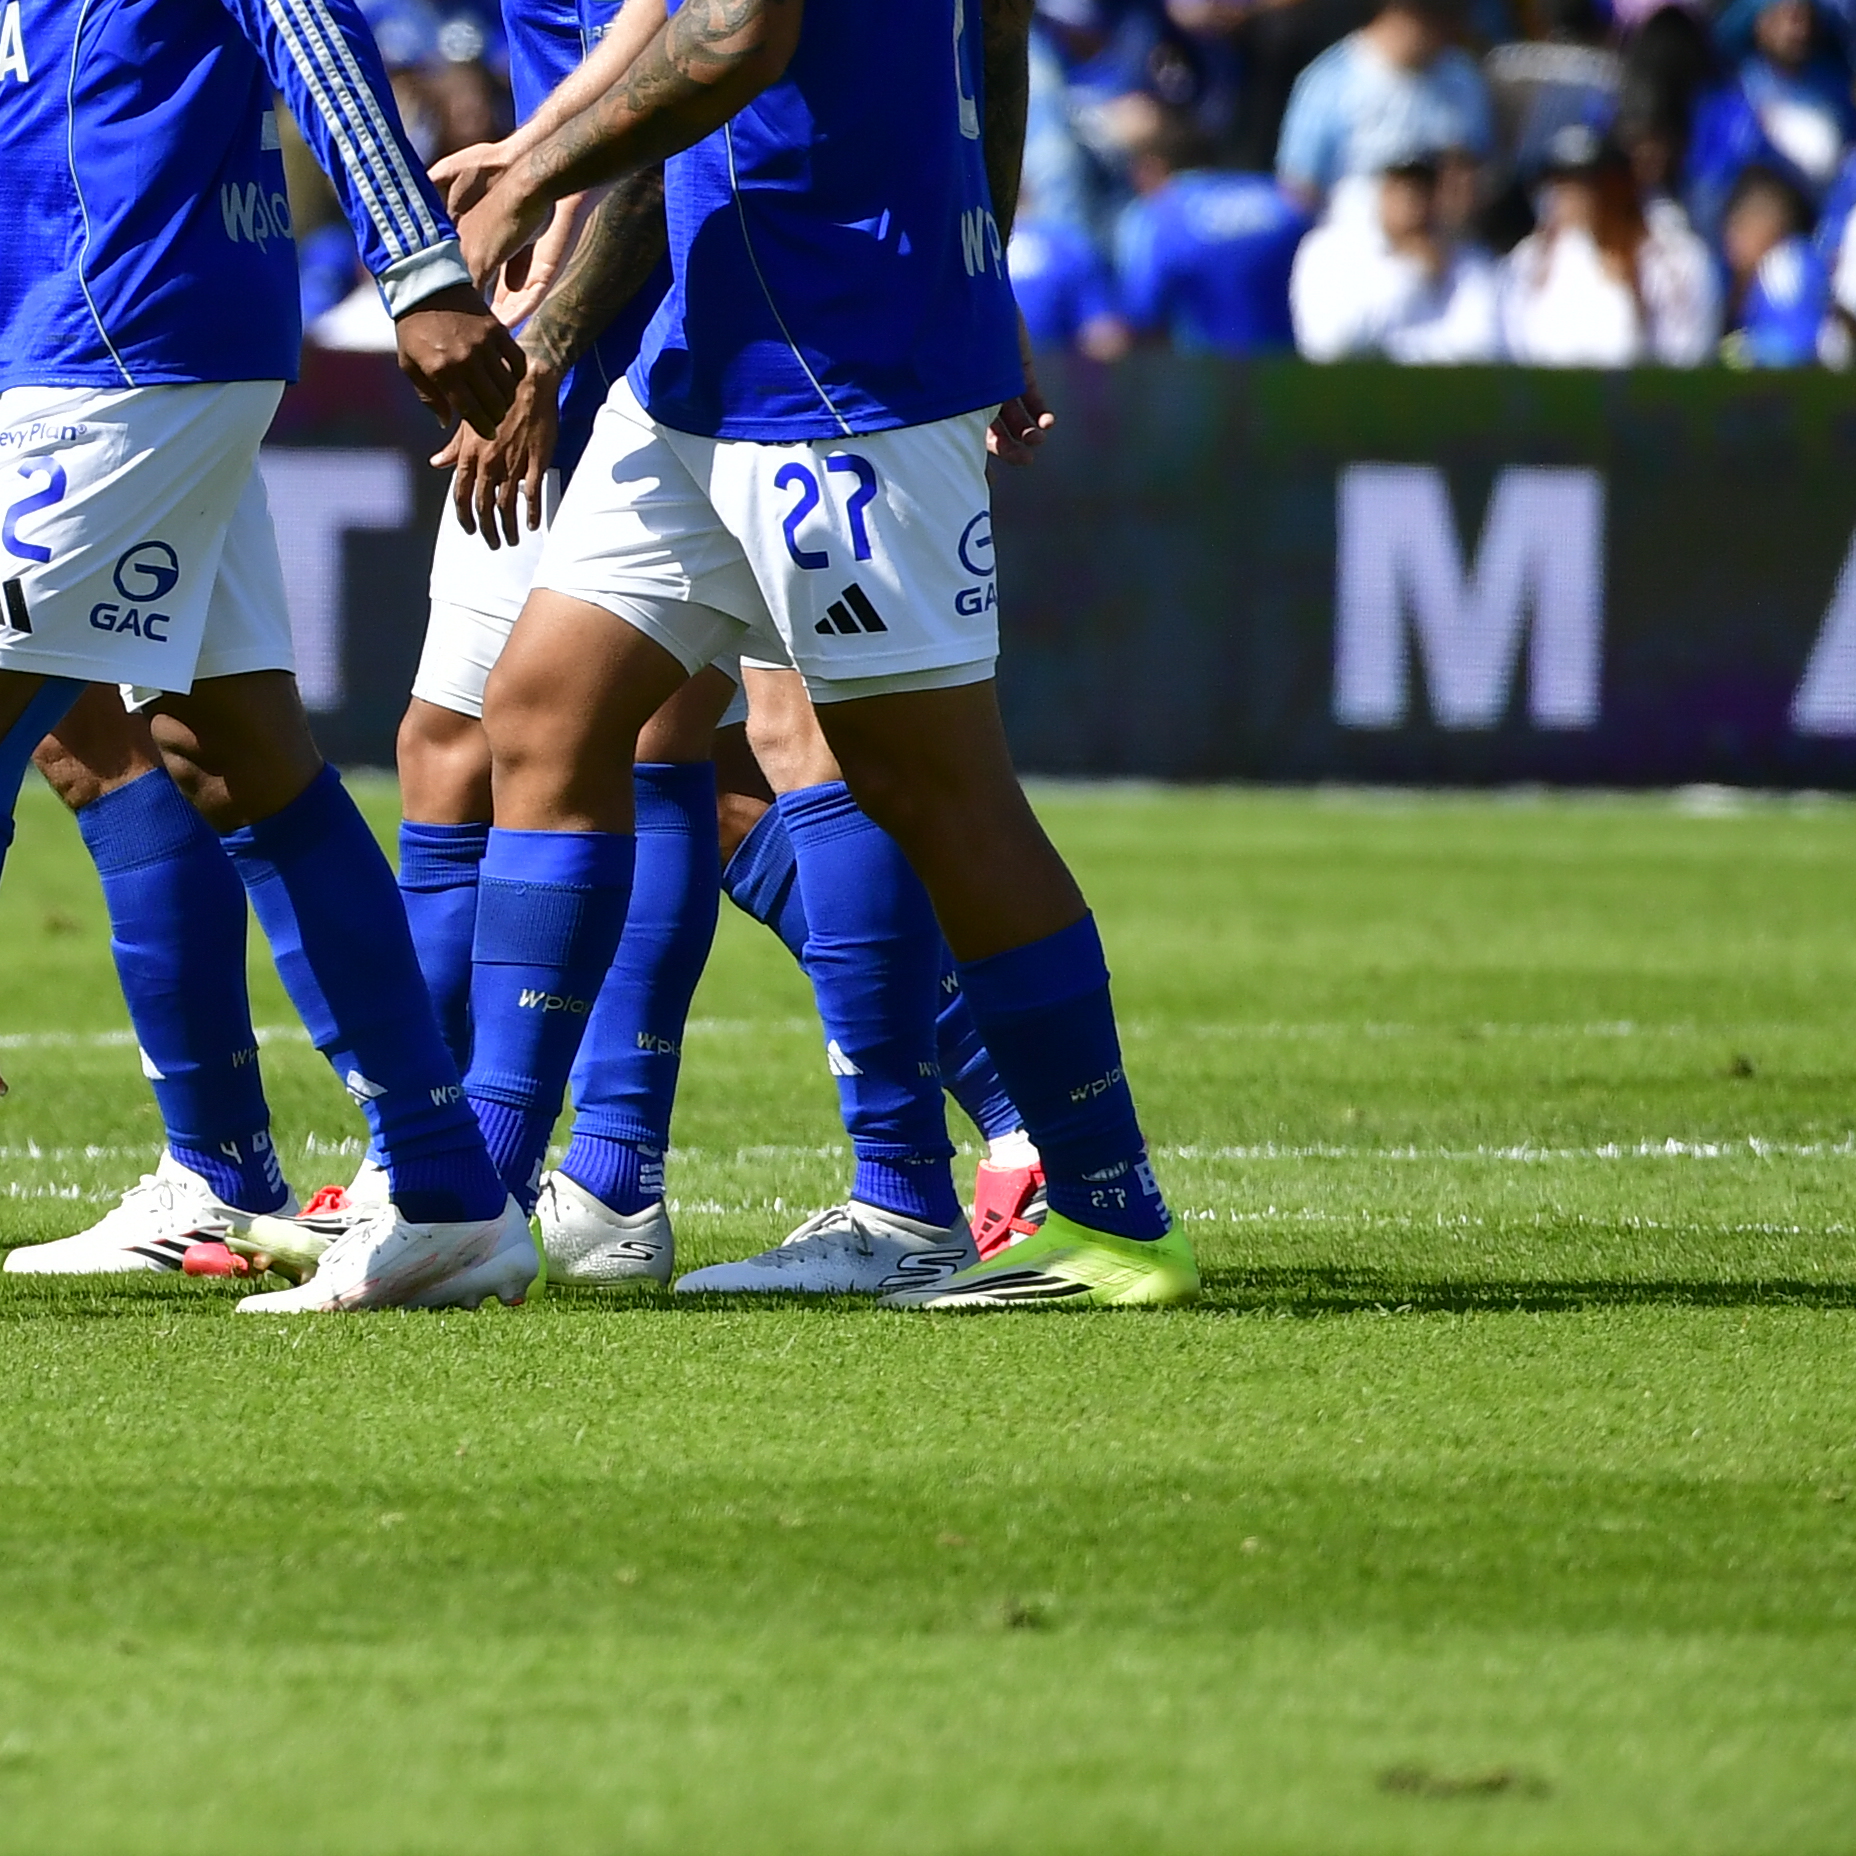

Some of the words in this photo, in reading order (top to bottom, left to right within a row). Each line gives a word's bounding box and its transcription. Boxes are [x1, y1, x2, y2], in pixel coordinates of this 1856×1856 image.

[2, 455, 68, 564] 2
[773, 453, 878, 571] 27
[89, 602, 171, 643] GAC
